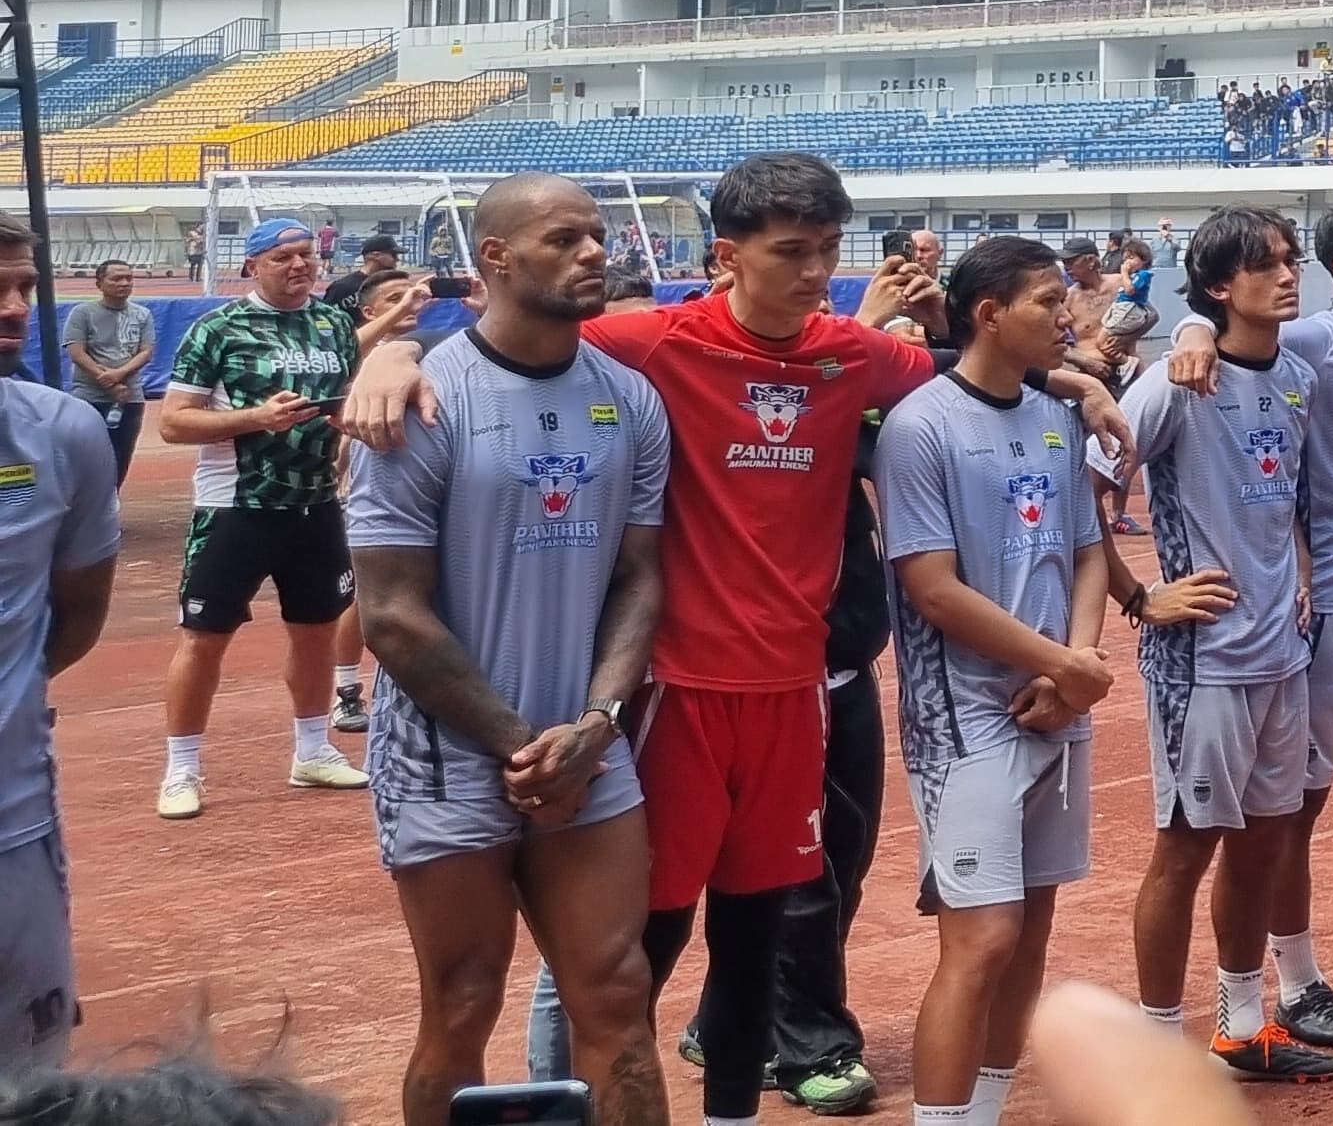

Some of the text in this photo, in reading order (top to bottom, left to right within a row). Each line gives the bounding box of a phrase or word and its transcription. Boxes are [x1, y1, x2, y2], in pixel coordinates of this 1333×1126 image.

[728, 83, 792, 99] PERSIB
[276, 348, 338, 361] We Are
[271, 359, 341, 374] PERSIB
[1258, 397, 1272, 412] 27
[538, 412, 559, 432] 19
[726, 443, 815, 462] PANTHER
[1009, 441, 1025, 458] 18
[728, 458, 778, 469] MINUMAN
[512, 520, 600, 544] PANTHER
[1002, 529, 1065, 550] PANTHER
[807, 809, 822, 843] 1
